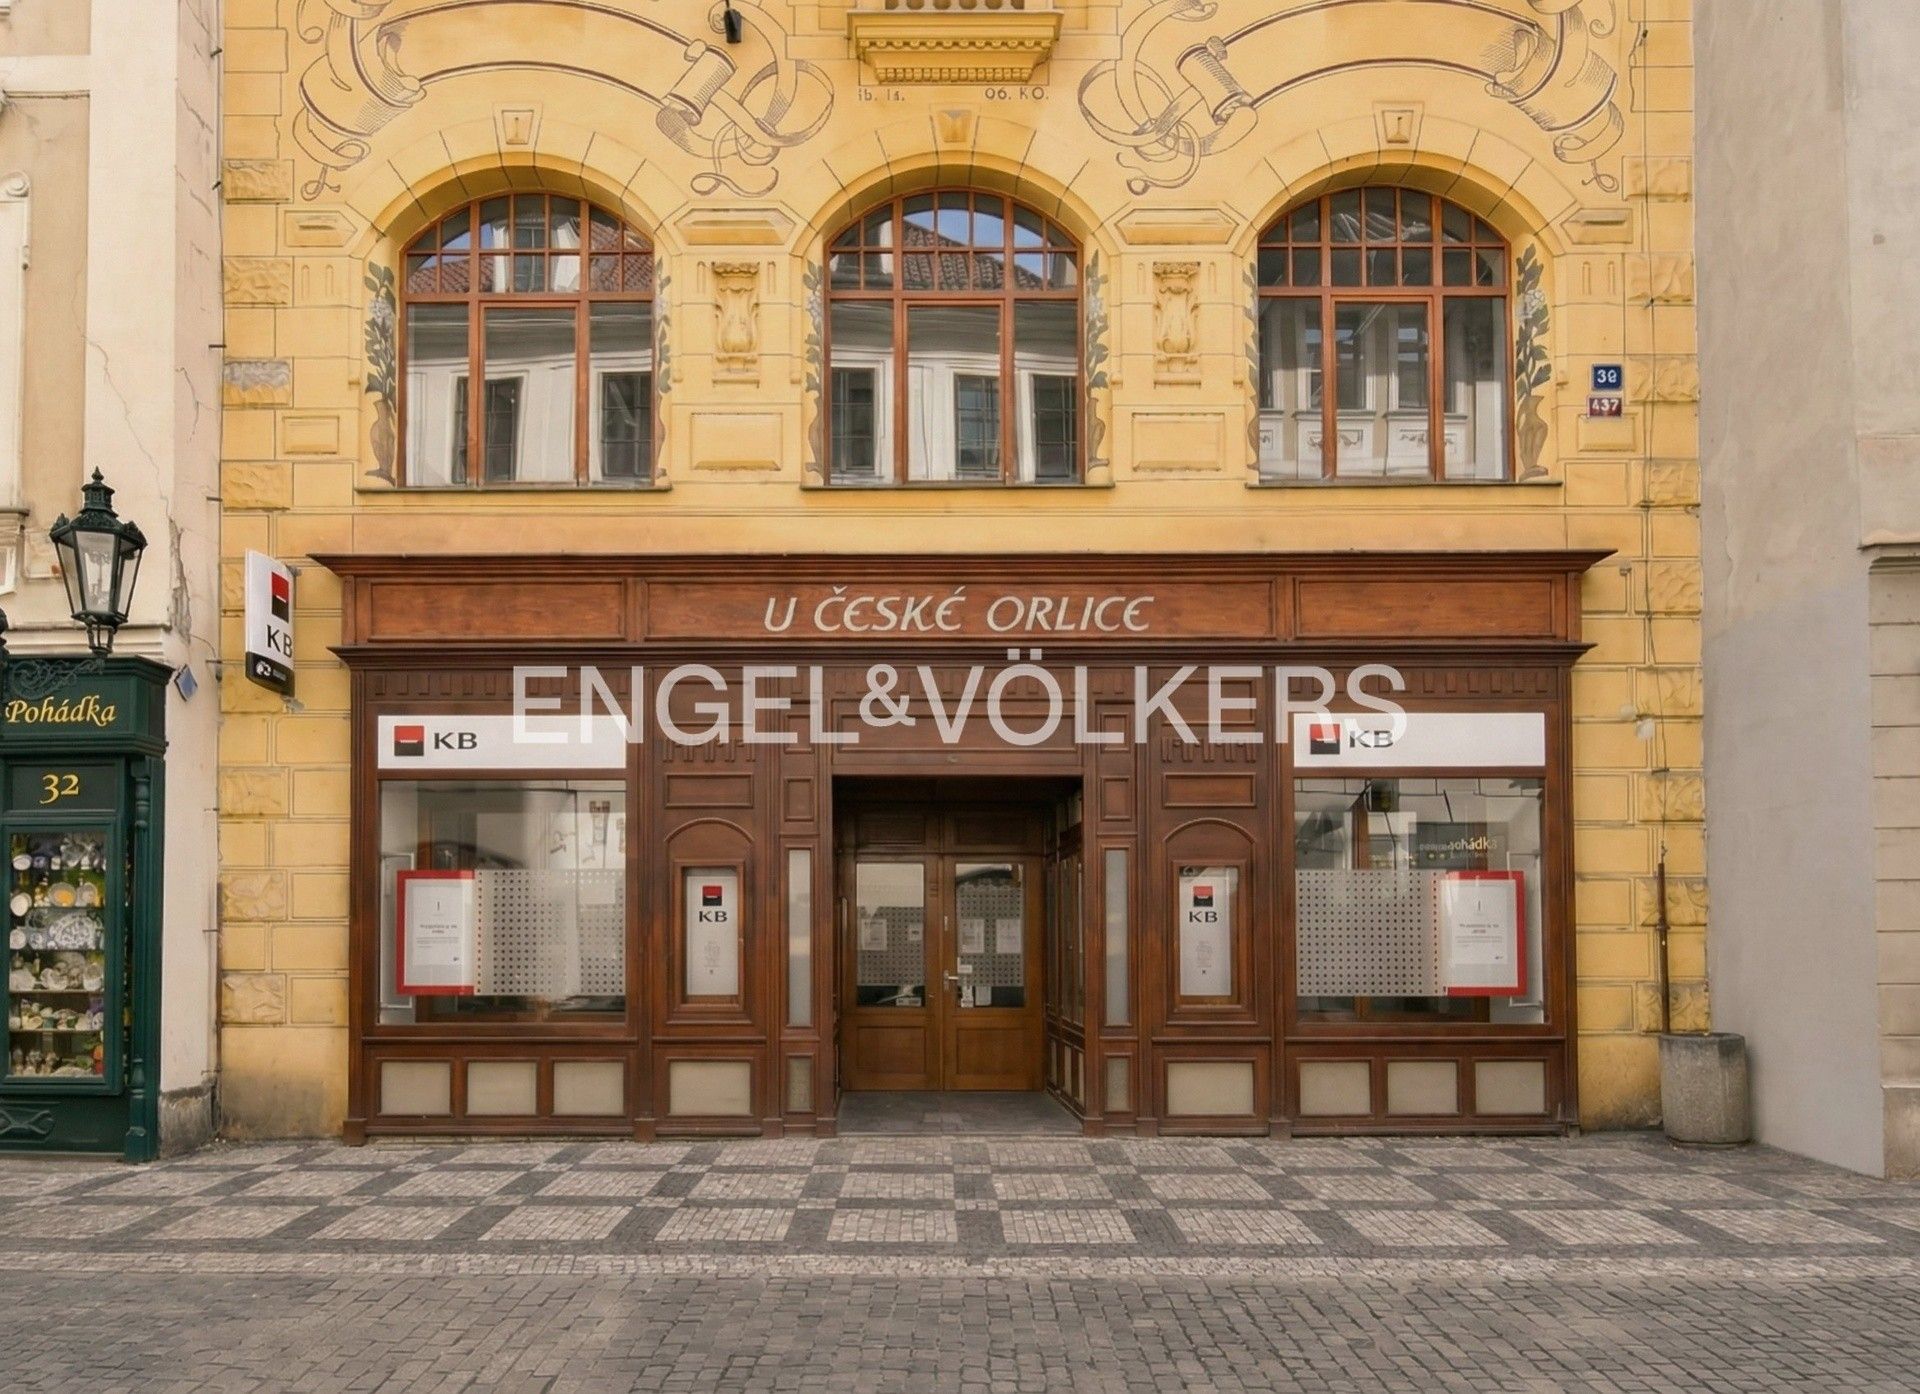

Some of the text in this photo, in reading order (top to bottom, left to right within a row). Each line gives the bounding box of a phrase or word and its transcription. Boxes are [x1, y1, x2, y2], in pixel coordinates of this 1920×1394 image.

[763, 585, 1155, 632] U ČESKÉ ORLICE
[267, 625, 293, 658] KB
[5, 694, 116, 727] Pohádka
[433, 732, 478, 750] KB
[1349, 729, 1394, 748] KB
[39, 773, 80, 805] 32
[698, 910, 728, 922] KB
[1188, 910, 1218, 923] KB
